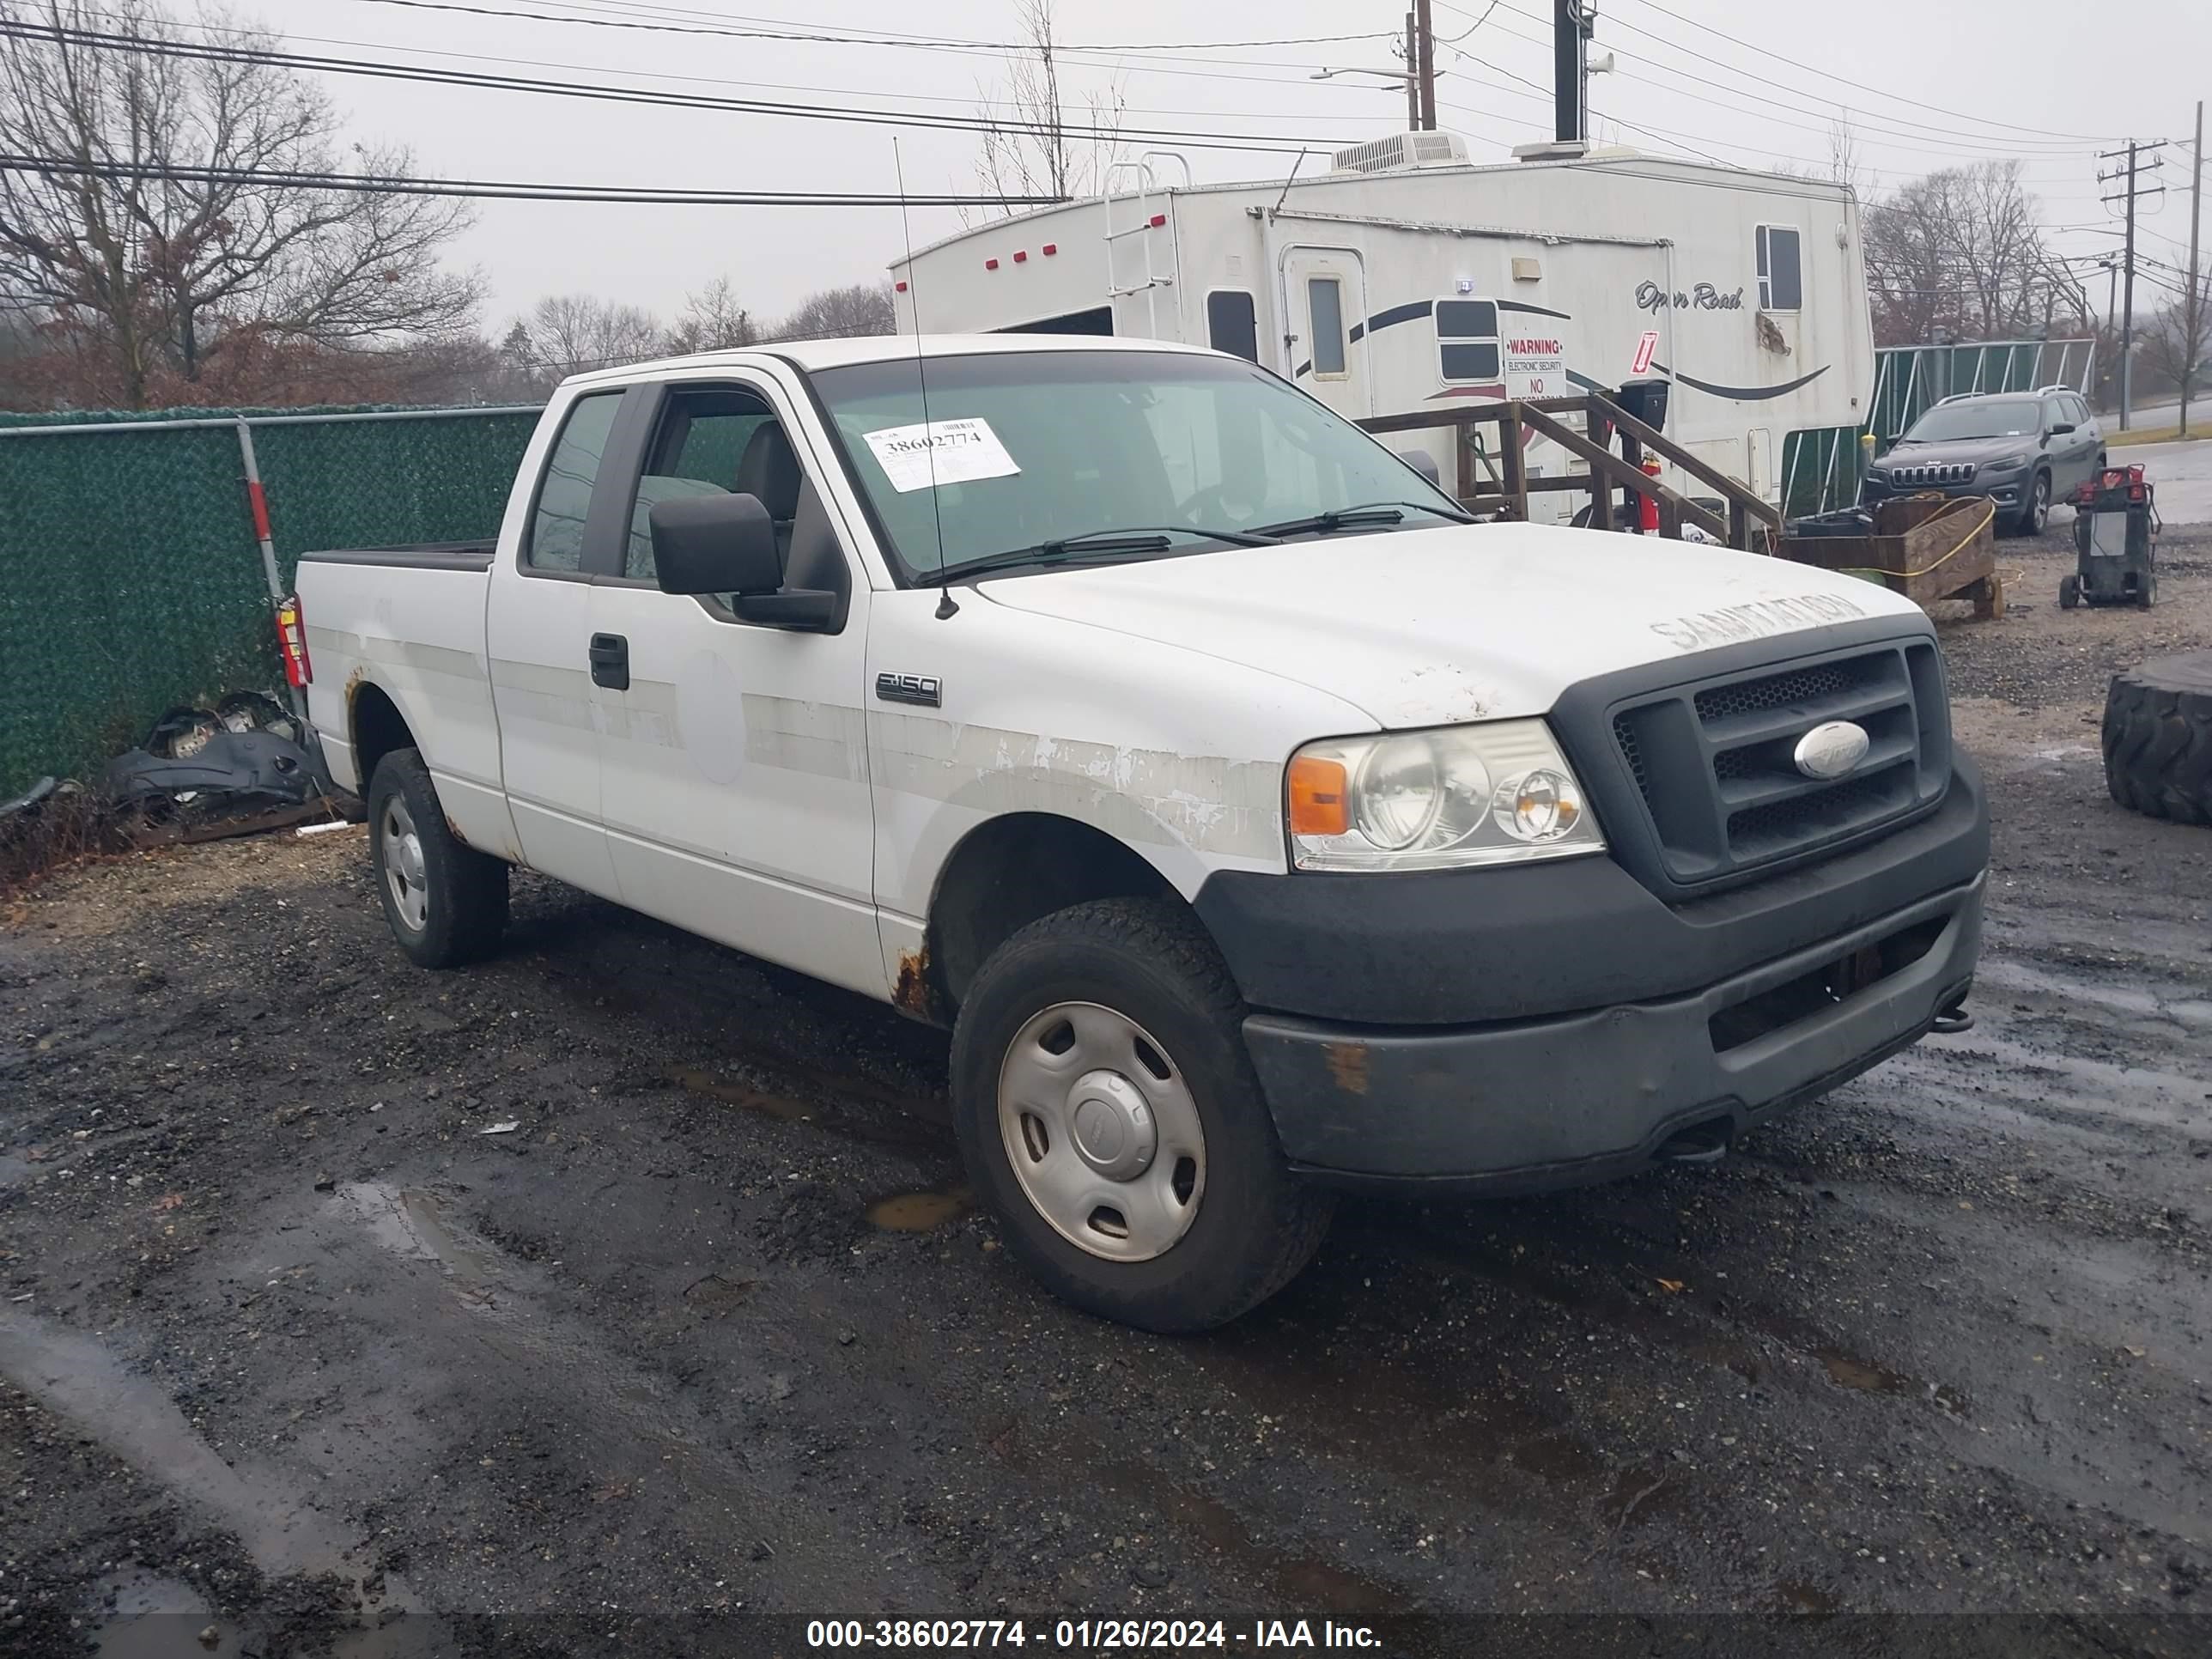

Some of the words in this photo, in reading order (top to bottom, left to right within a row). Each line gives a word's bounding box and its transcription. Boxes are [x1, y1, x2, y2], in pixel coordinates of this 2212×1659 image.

[1635, 280, 1689, 315] Opn
[1693, 283, 1743, 310] Road
[1509, 339, 1559, 355] WARNING
[1509, 362, 1538, 371] ELECTRONIC
[1539, 362, 1562, 371] SECURITY
[1530, 379, 1543, 393] NO
[884, 432, 982, 455] 38602774
